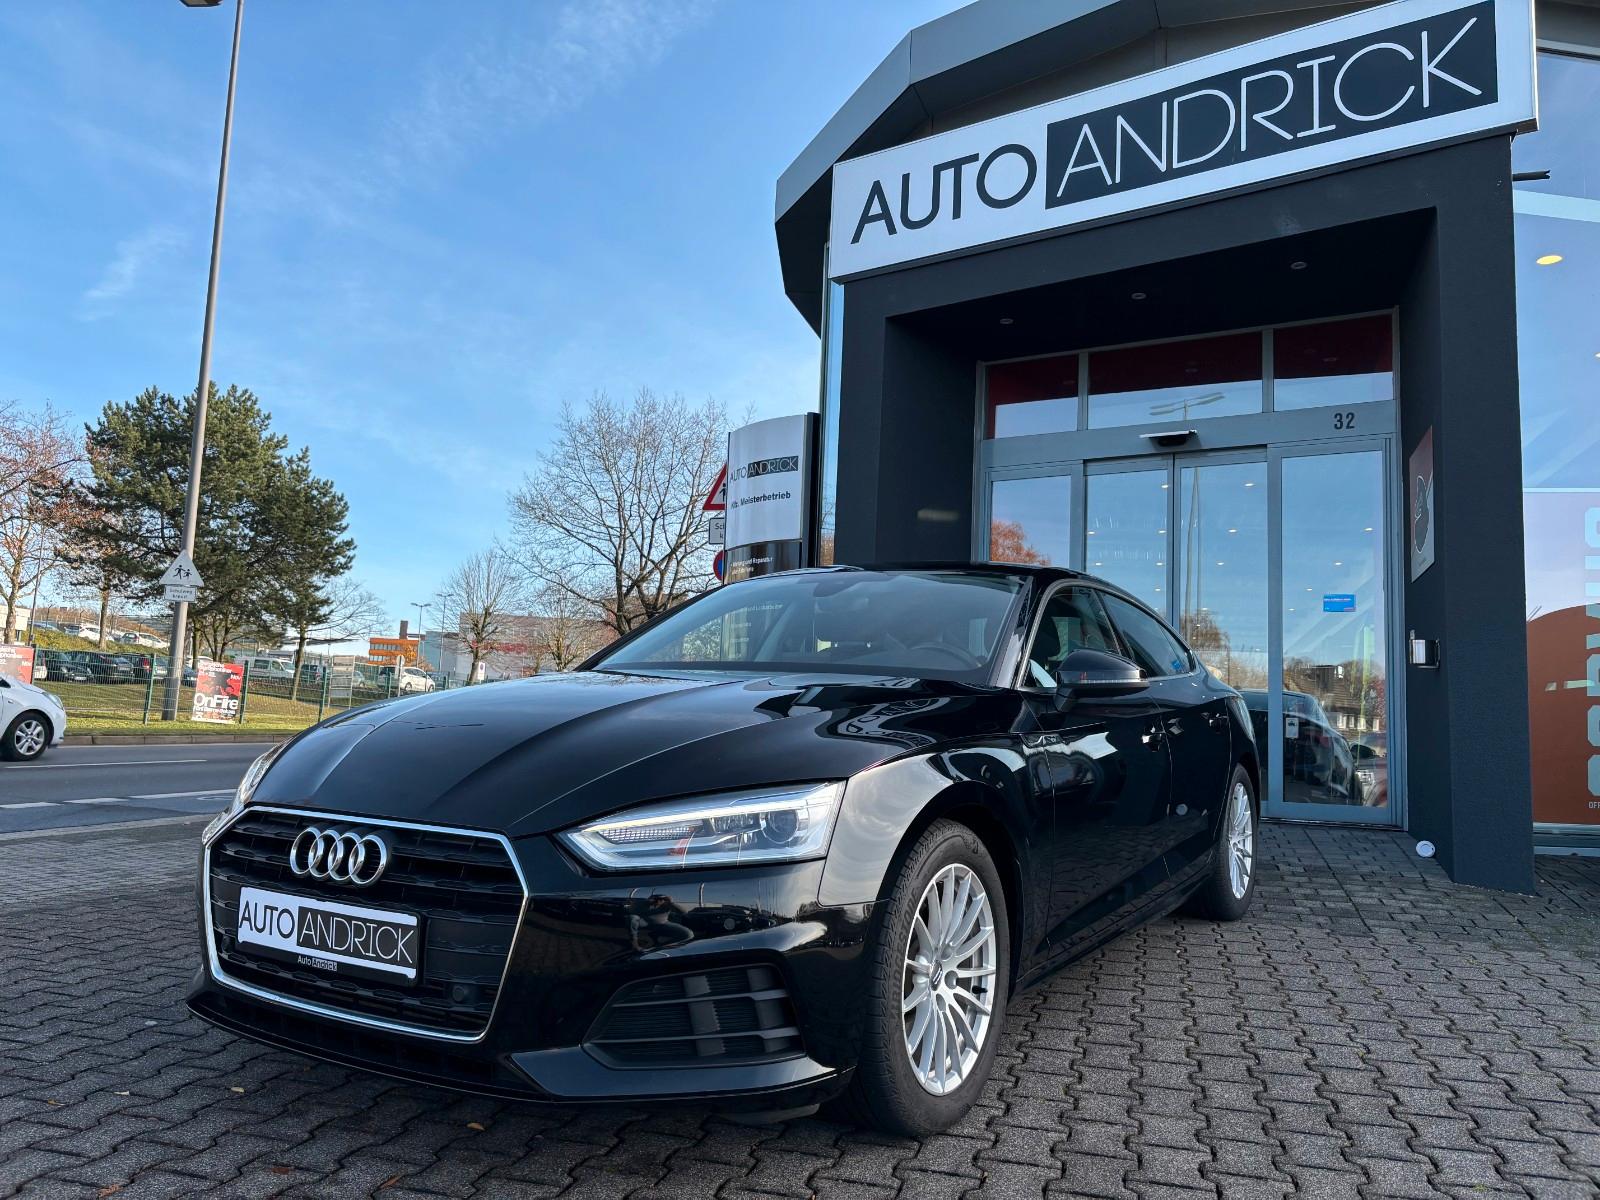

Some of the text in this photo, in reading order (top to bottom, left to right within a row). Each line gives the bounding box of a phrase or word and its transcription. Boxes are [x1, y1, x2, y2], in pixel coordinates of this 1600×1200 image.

[850, 17, 1482, 245] AUTO ANDRICK
[1334, 412, 1355, 430] 32
[730, 457, 797, 482] AUTO ANDRICK
[740, 490, 791, 506] Meisterbetrieb
[238, 899, 414, 964] AUTO ANDRICK
[297, 955, 313, 967] Auto
